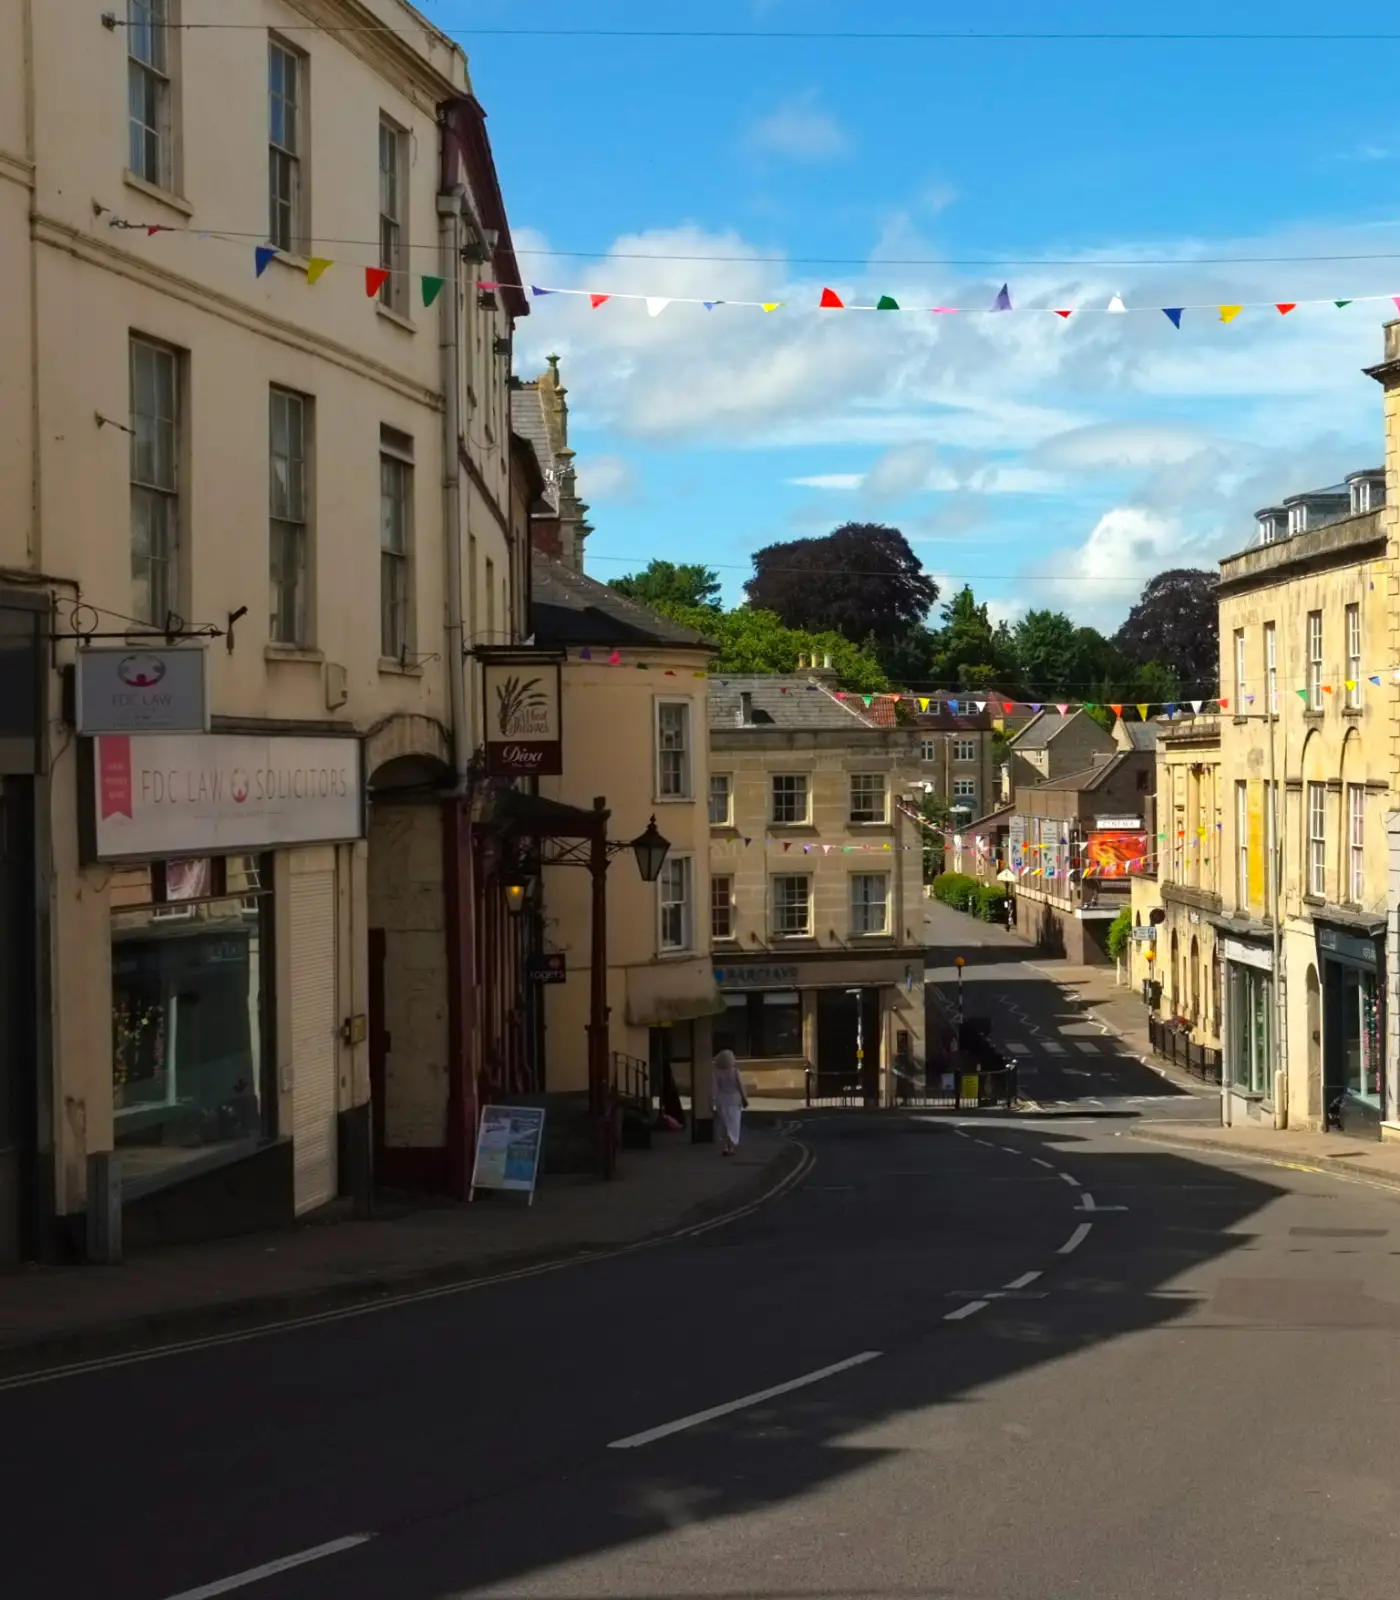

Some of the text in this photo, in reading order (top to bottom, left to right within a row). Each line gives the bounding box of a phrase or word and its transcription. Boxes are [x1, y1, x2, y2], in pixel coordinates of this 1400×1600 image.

[142, 693, 174, 708] LAW
[502, 745, 542, 763] Diva
[141, 767, 348, 804] FDC LAW SOLICITORS
